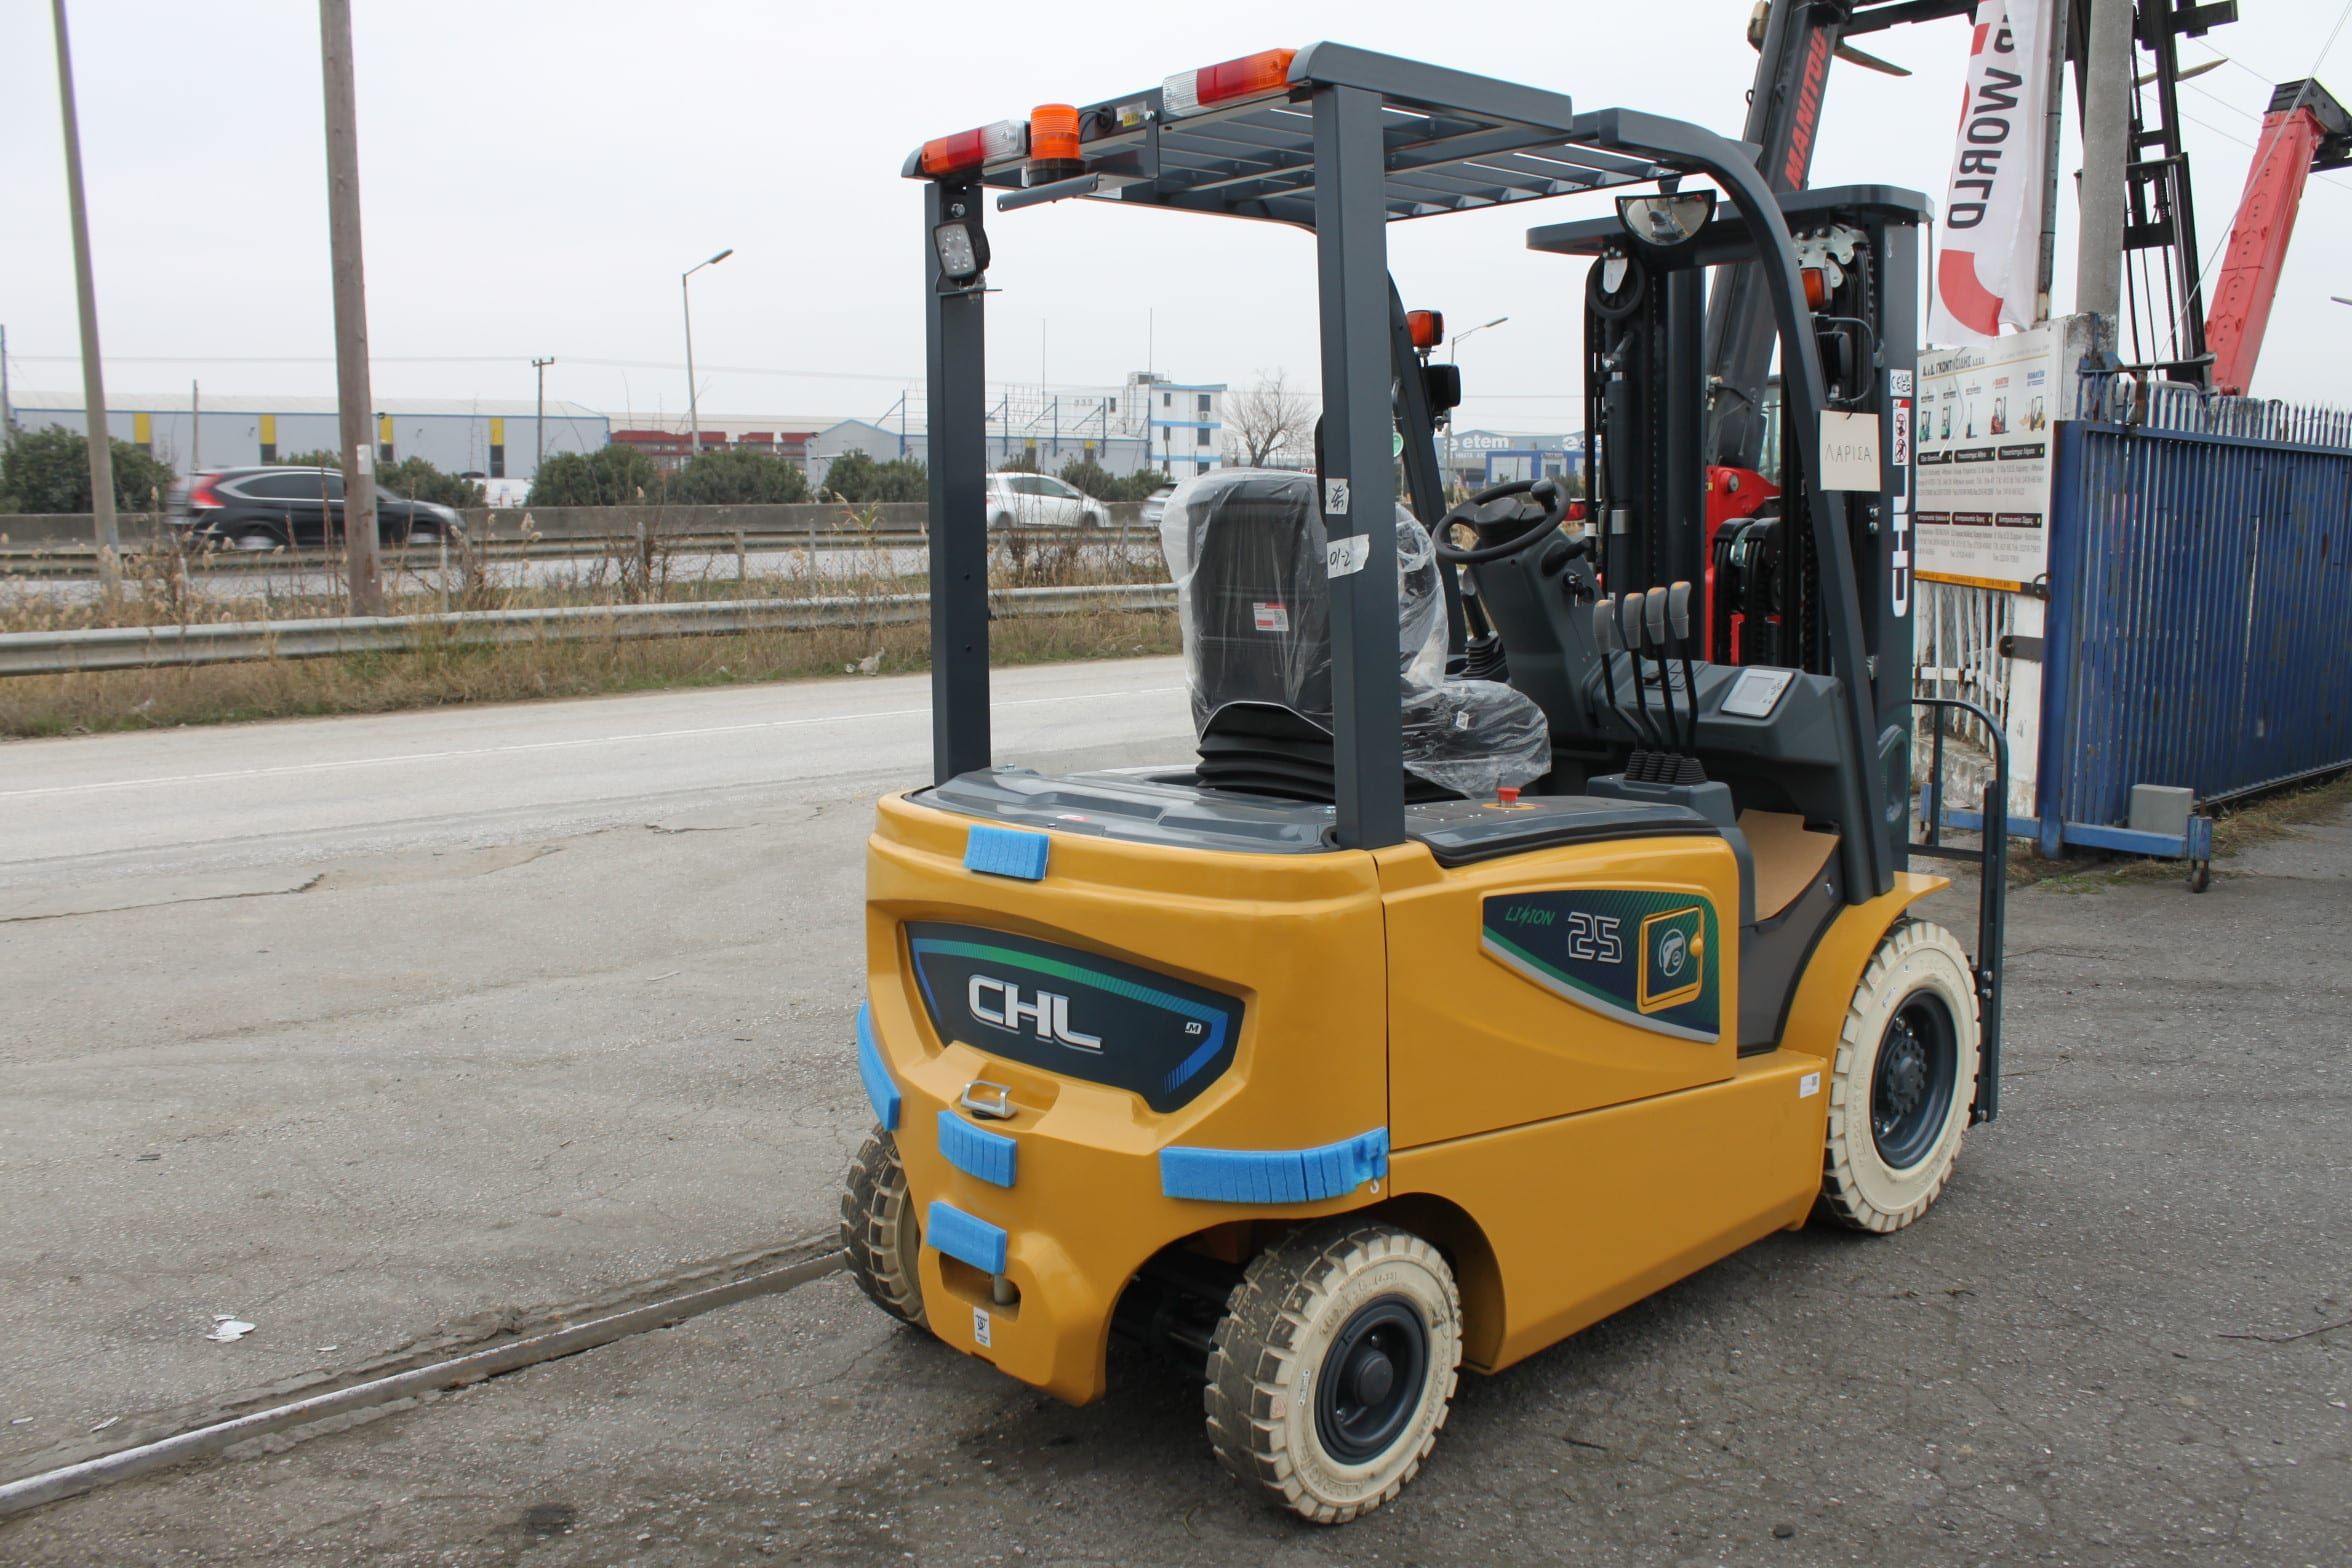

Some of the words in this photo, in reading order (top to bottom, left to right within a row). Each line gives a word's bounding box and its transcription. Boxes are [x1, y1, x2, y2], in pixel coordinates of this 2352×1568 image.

[1785, 25, 1828, 191] MANITOU
[1462, 434, 1509, 449] etem
[1567, 912, 1622, 964] 25
[968, 974, 1103, 1054] CHL
